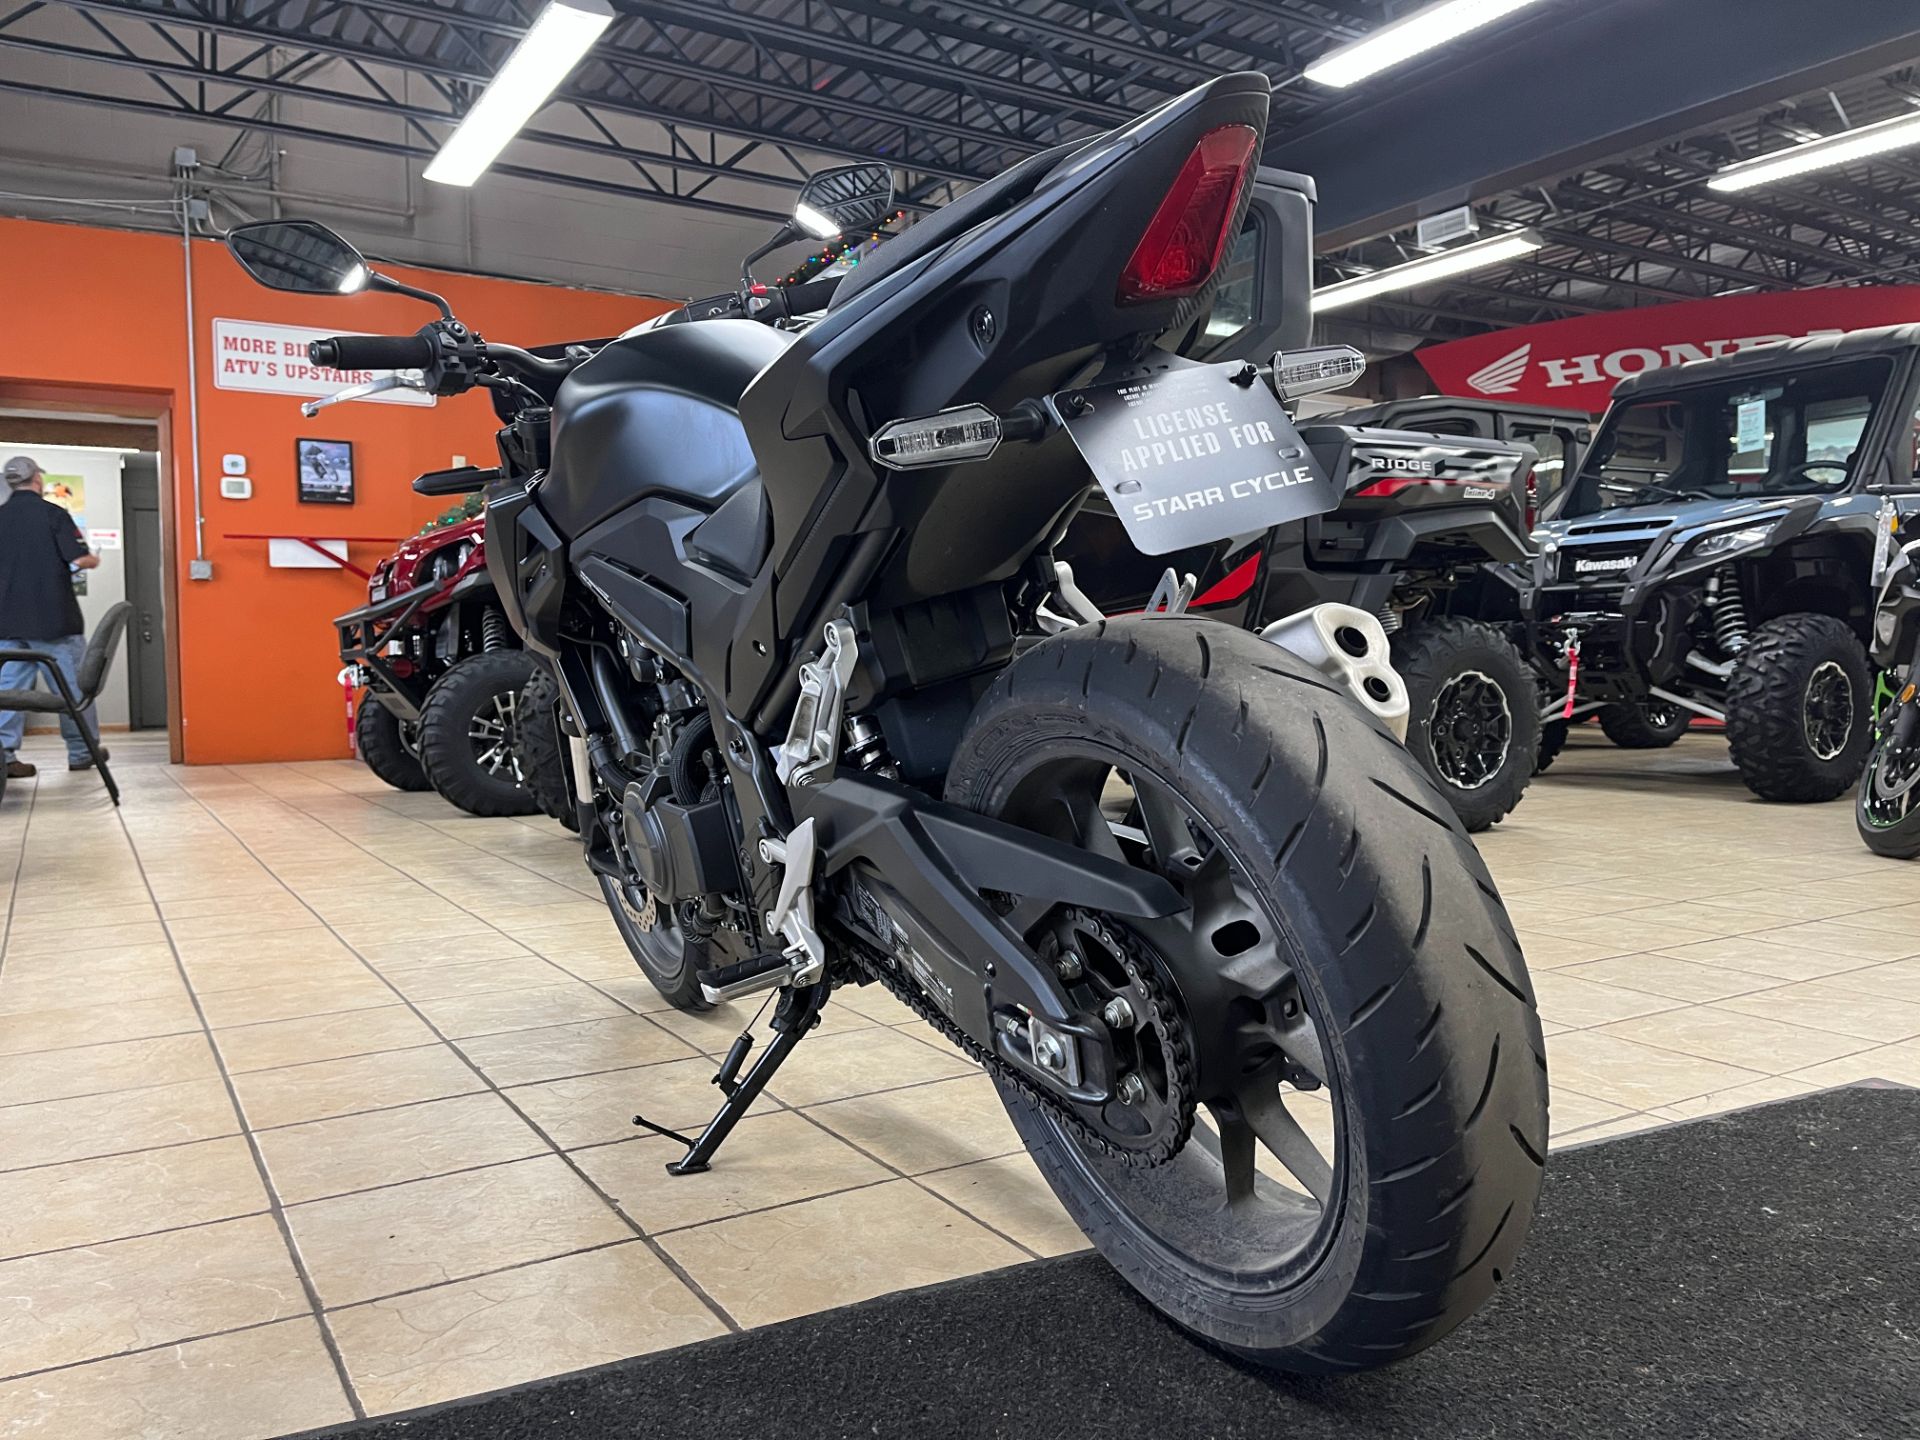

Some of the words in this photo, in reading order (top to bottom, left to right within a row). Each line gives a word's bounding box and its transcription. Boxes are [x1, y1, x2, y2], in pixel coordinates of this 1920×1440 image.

[223, 336, 276, 355] MORE
[1538, 329, 1844, 387] HON
[224, 358, 277, 377] ATV'S
[285, 363, 373, 385] UPSTAIRS
[1133, 403, 1233, 440] LICENSE
[1121, 432, 1221, 472] APPLIED
[1229, 420, 1276, 449] FOR
[1371, 458, 1432, 471] RIDGE
[1133, 486, 1225, 522] STARR
[1230, 466, 1314, 499] CYCLE
[1575, 556, 1638, 573] Kawasaki
